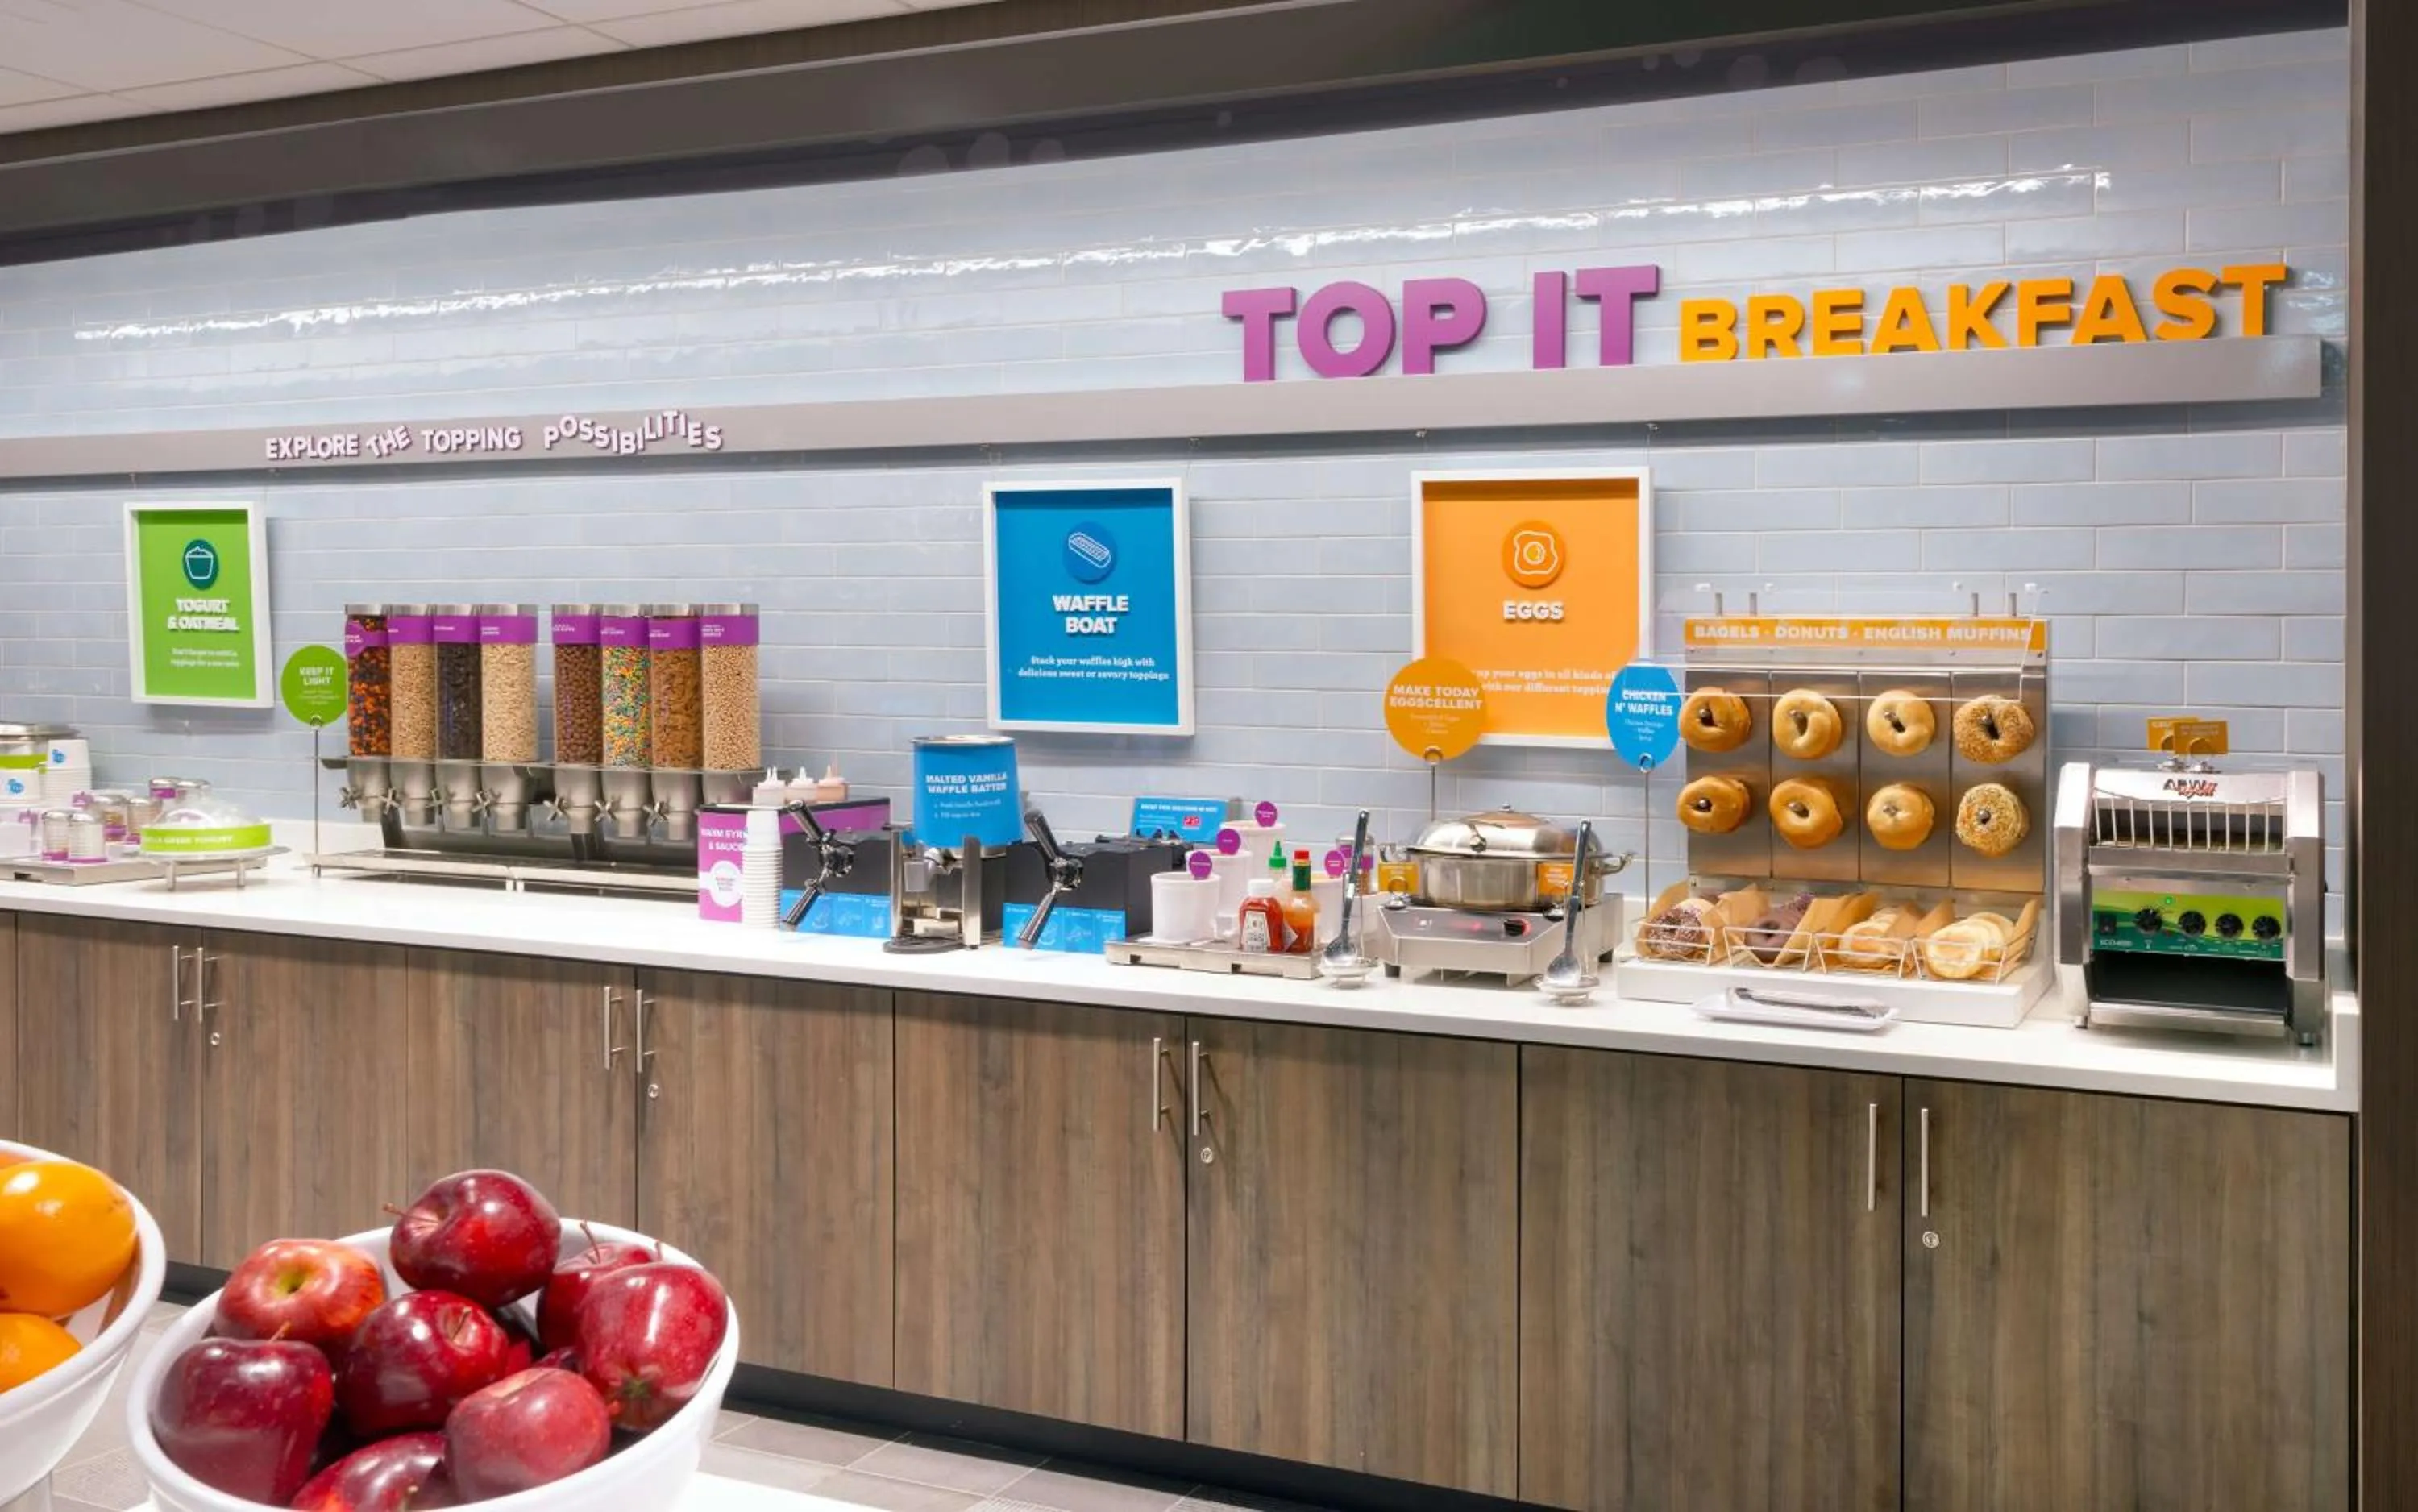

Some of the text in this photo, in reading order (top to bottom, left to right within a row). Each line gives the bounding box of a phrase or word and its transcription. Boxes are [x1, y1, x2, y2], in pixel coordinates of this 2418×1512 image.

[1679, 264, 2290, 363] BREAKFAST
[1221, 264, 1660, 382] TOP IT
[265, 409, 723, 460] EXPLORE THE TOPPING POSSIBILITIES
[1053, 594, 1129, 613] WAFFLE
[1502, 600, 1565, 620] EGGS
[1066, 617, 1118, 634] BOAT
[1694, 625, 2032, 642] BAGELS DONUTS ENGLISH MUFFINS
[1057, 657, 1077, 668] your
[1079, 655, 1111, 667] waffles
[1135, 657, 1155, 667] with
[299, 667, 334, 676] KEEP IT
[1018, 667, 1170, 682] delicious sweet or savory toppings
[1492, 670, 1516, 680] your
[1518, 671, 1543, 682] eggs
[303, 676, 332, 686] LIGHT
[1392, 683, 1479, 698] MAKE TODAY
[1622, 689, 1666, 702] CHICKEN
[1389, 696, 1483, 710] EGGSCELLENT
[1627, 702, 1673, 716] WAFFLES
[925, 774, 966, 784] MALTED
[928, 783, 969, 794] WAFFLE
